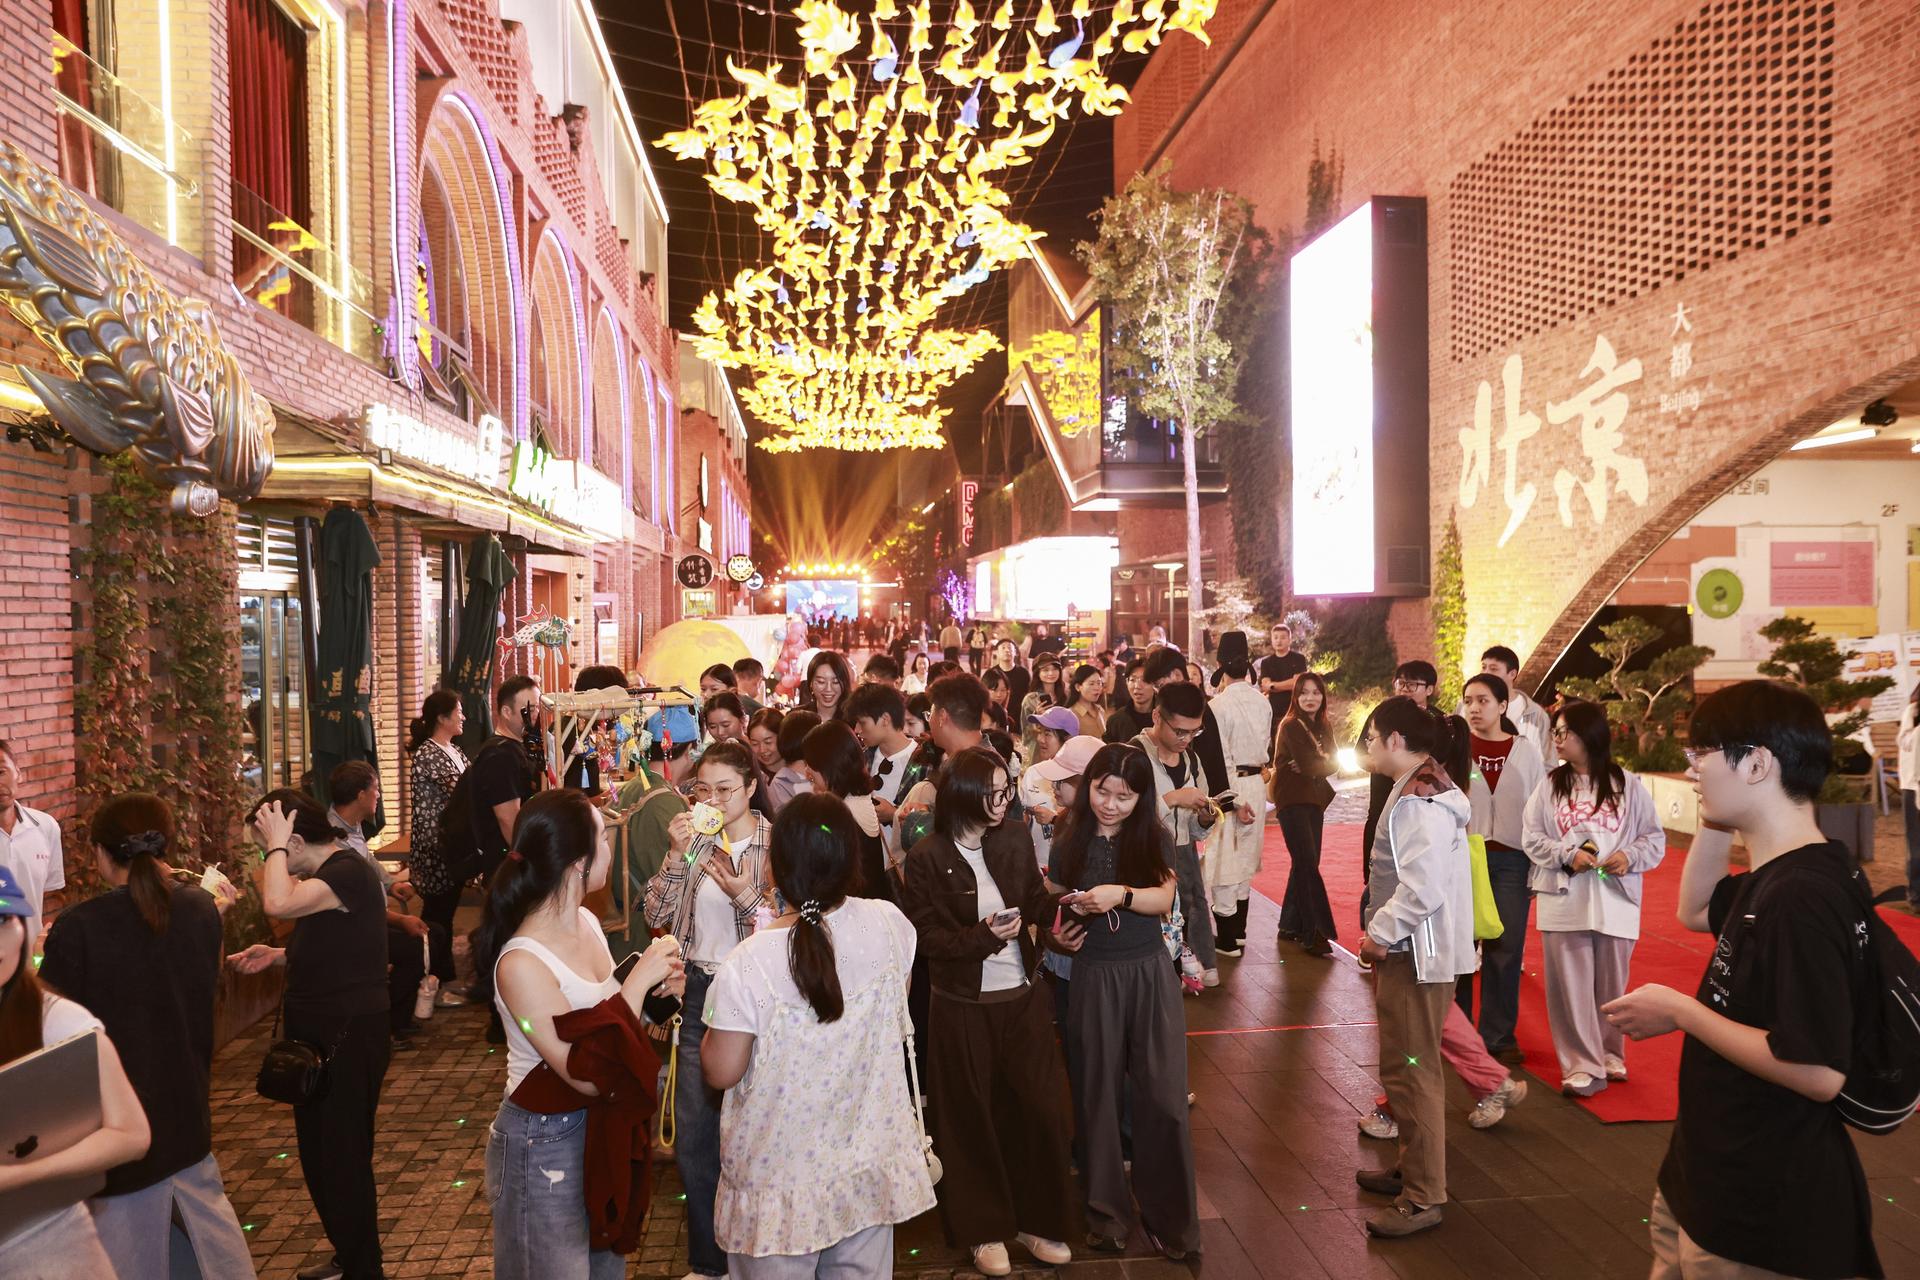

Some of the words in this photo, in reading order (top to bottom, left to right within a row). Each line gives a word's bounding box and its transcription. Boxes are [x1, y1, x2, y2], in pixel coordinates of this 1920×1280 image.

[1670, 302, 1692, 378] 大都
[1660, 389, 1700, 414] Beijing
[1458, 334, 1649, 548] 北京
[1727, 479, 1770, 496] 空间
[1881, 504, 1899, 518] 2F
